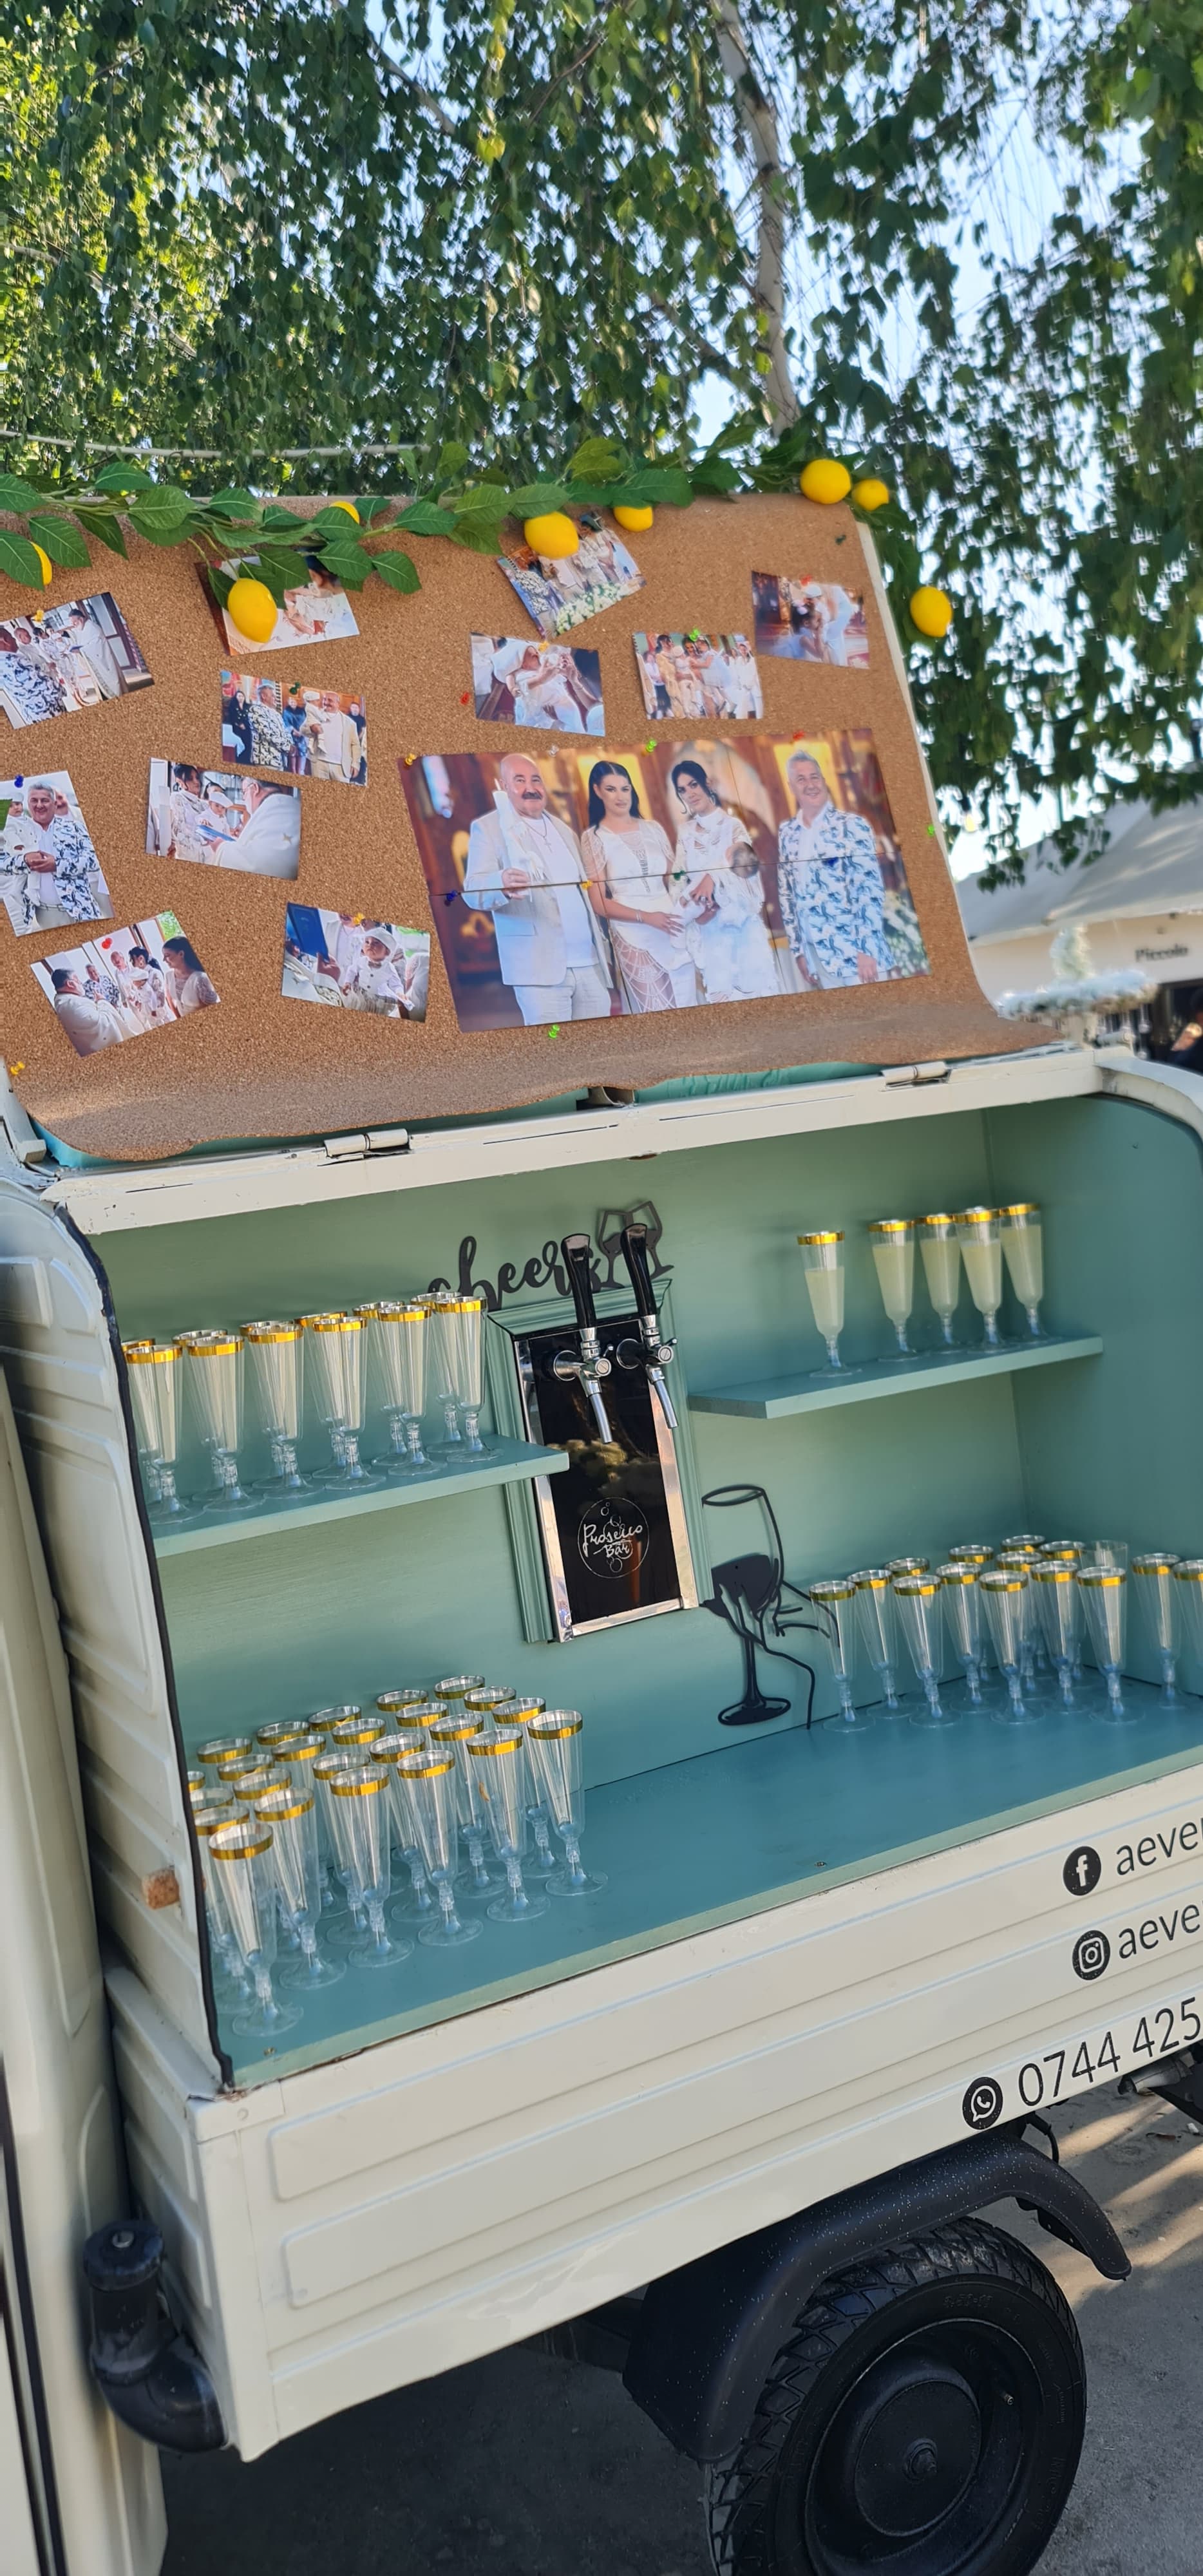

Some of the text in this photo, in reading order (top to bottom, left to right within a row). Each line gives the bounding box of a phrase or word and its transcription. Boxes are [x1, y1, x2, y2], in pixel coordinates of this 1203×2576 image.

[605, 1543, 630, 1558] Bar
[1115, 1817, 1203, 1876] aeve
[1118, 1901, 1203, 1959] aeve
[1018, 1996, 1201, 2107] 0744 425
